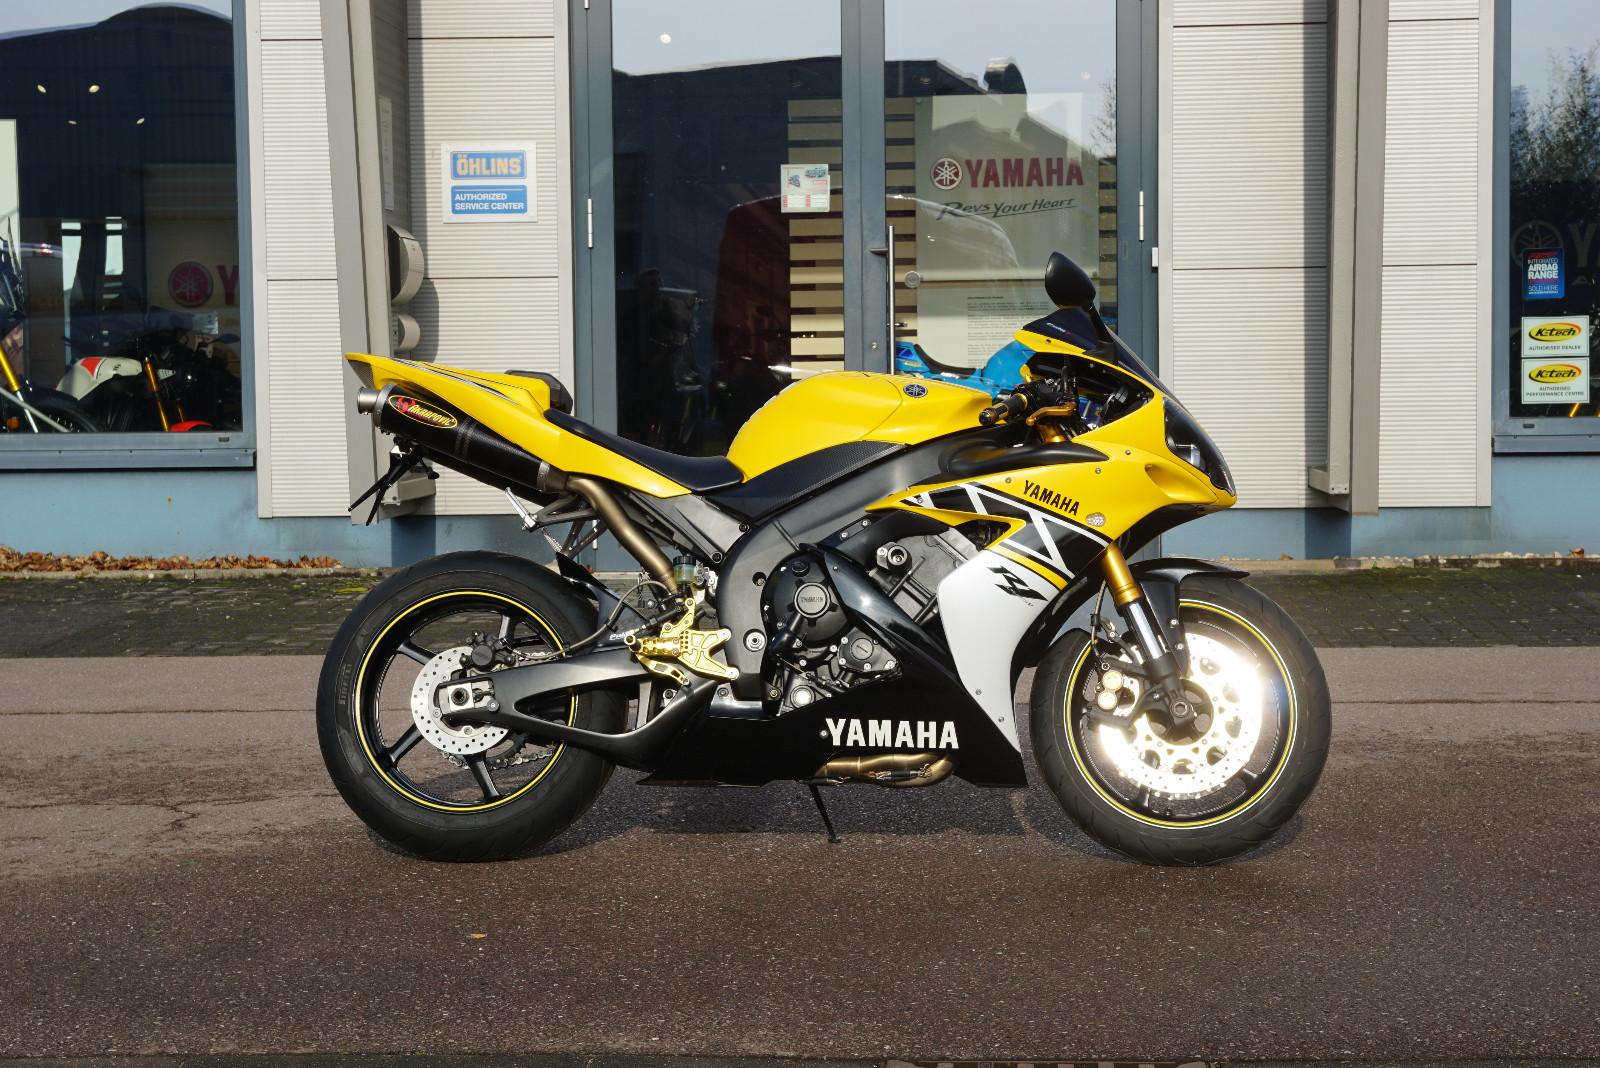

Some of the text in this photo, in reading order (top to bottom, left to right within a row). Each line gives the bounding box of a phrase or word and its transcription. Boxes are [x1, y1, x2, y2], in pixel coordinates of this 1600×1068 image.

[457, 154, 520, 176] ÖHLINS
[965, 157, 1084, 188] YAMAHA
[454, 193, 508, 201] AUTHORIZED
[455, 202, 524, 210] SERVICE CENTER
[936, 198, 1075, 220] Revs Your Heart
[1528, 263, 1559, 272] AIRBAG
[1528, 271, 1559, 280] RANGE
[1023, 479, 1080, 516] YAMAHA
[825, 717, 960, 750] YAMAHA
